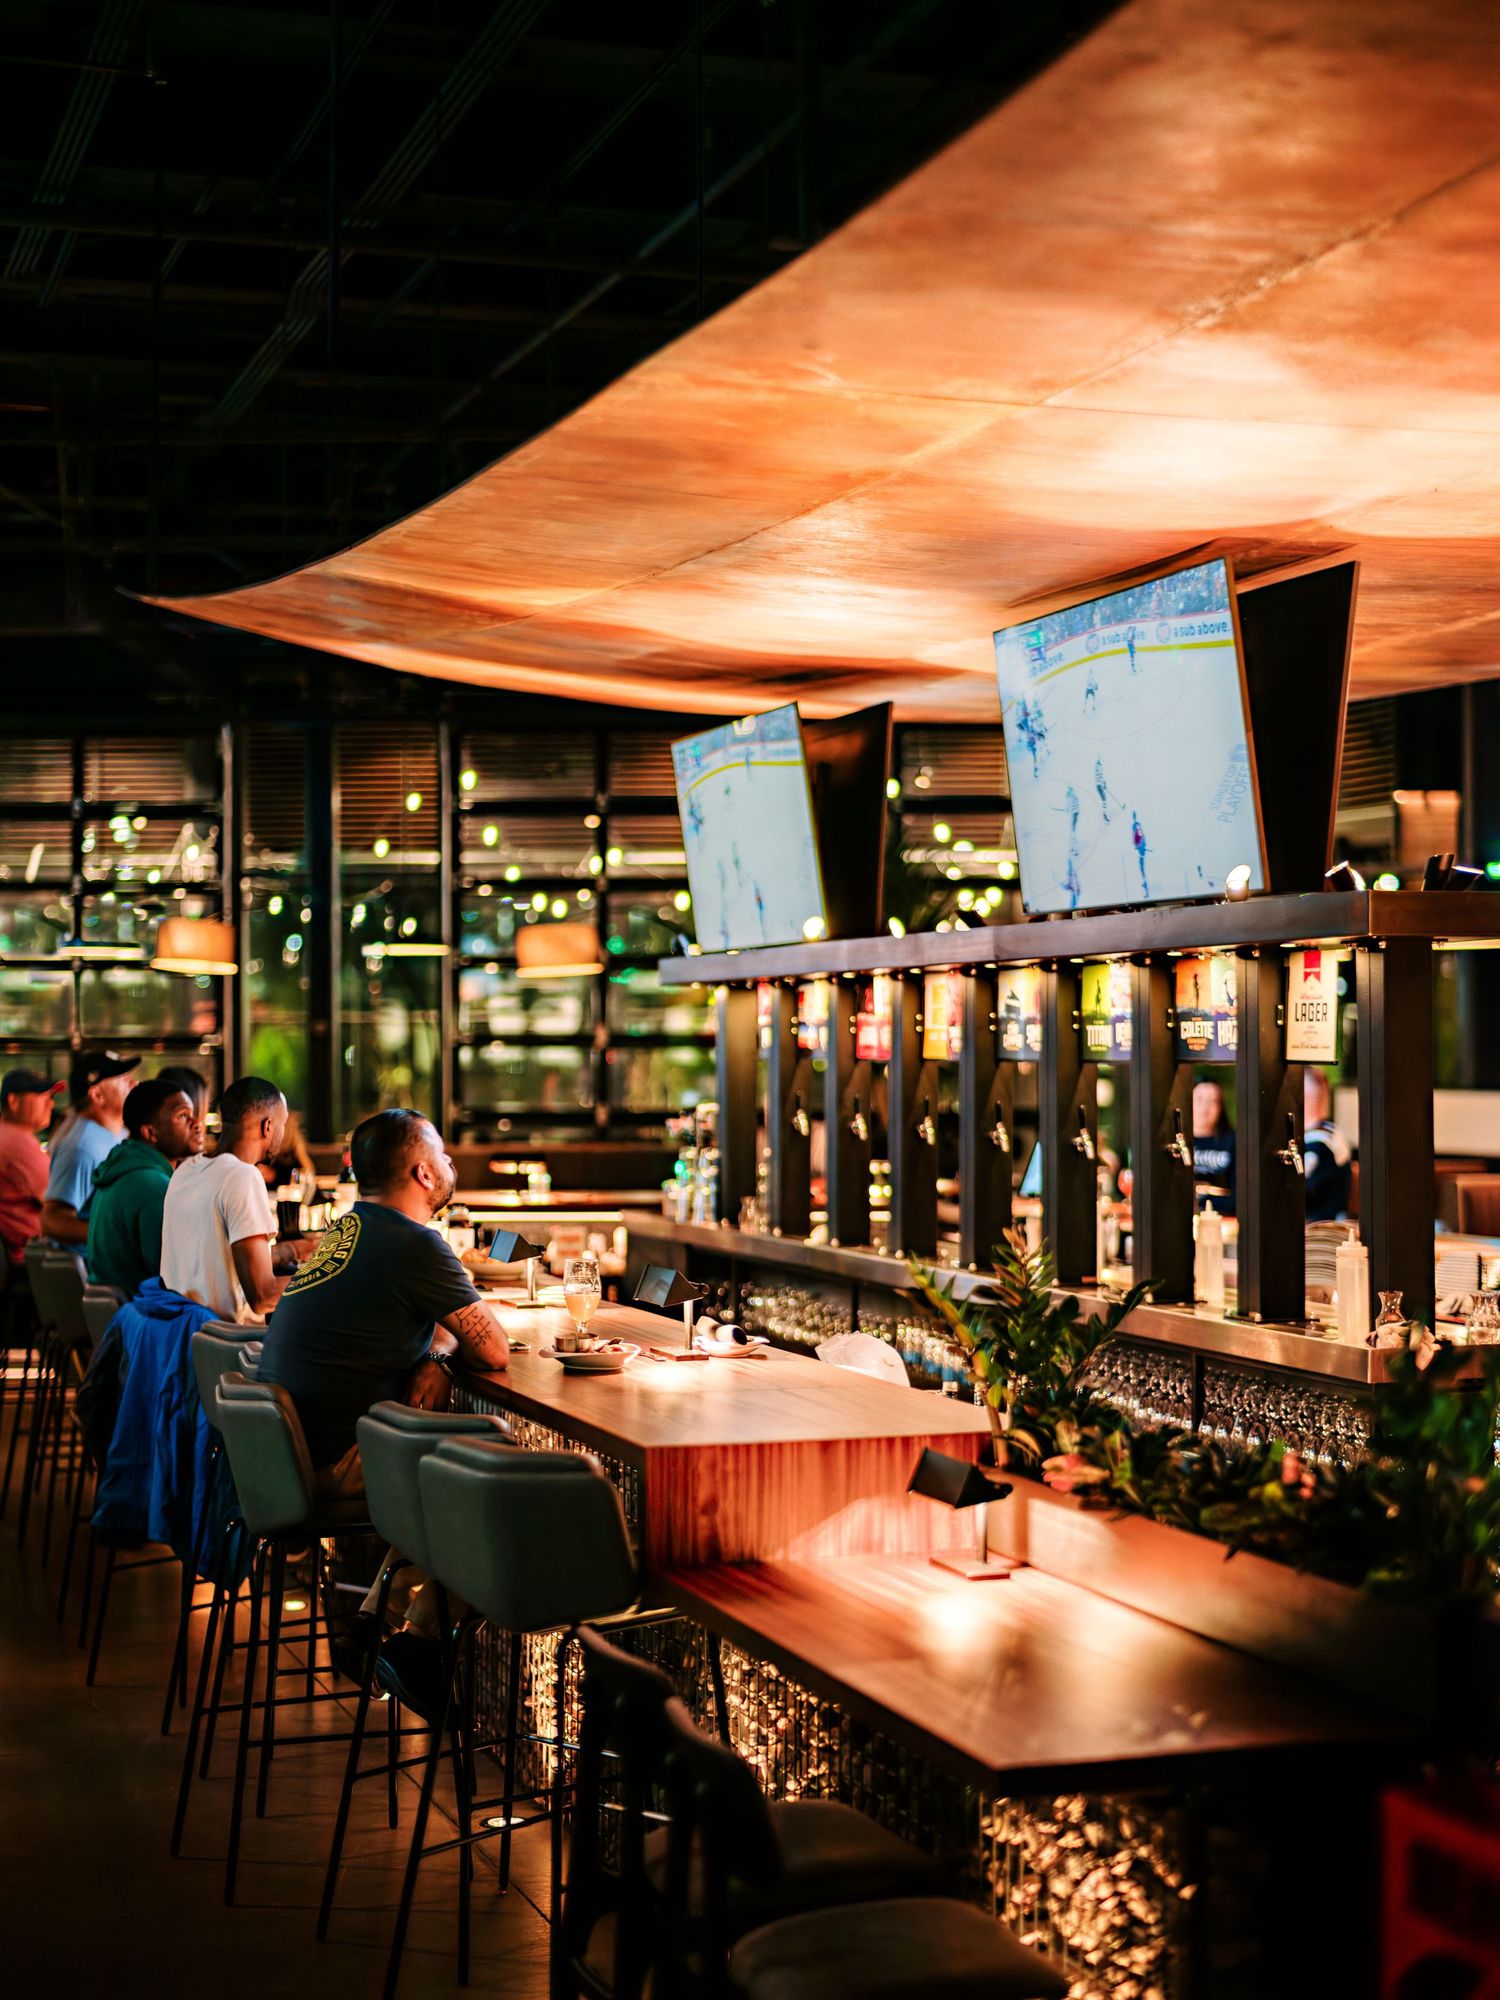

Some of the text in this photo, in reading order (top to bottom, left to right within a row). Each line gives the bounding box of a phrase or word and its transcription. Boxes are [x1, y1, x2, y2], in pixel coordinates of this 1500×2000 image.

[1173, 627, 1179, 638] a
[1180, 623, 1196, 637] sub
[1295, 1002, 1328, 1022] LAGER
[1181, 1020, 1214, 1040] COLETTE
